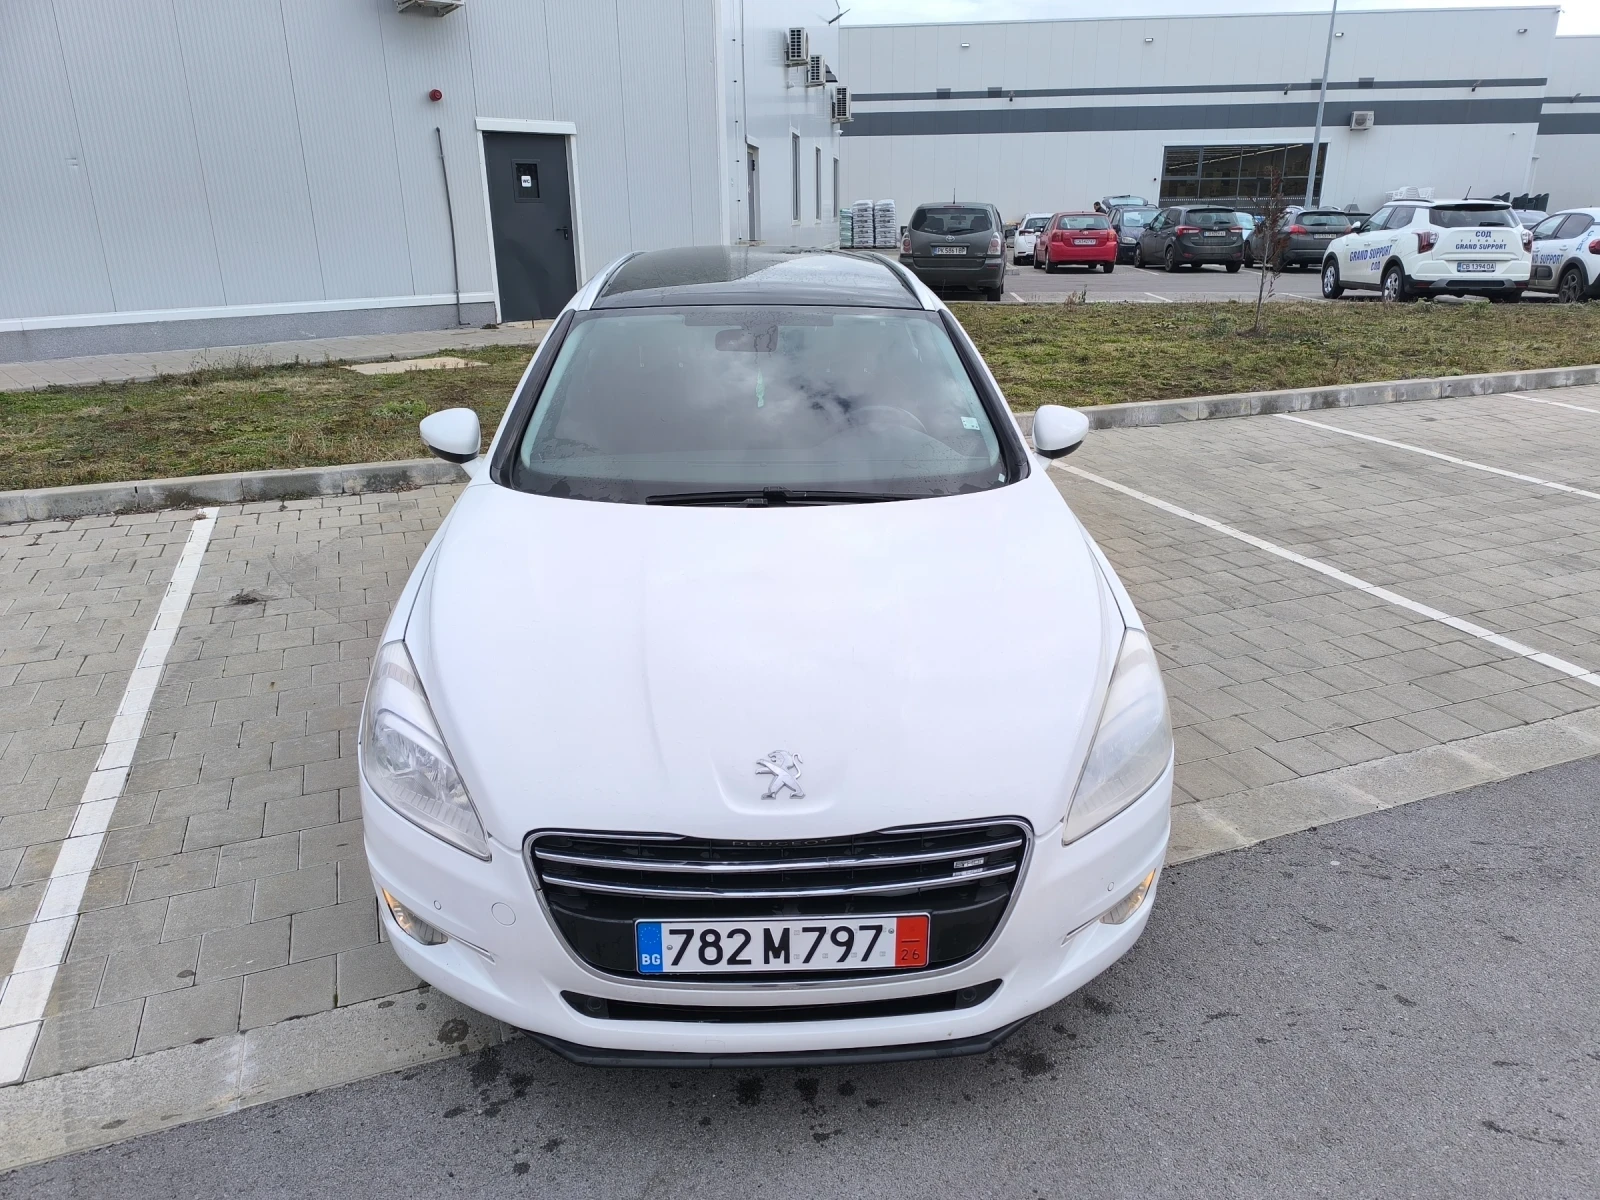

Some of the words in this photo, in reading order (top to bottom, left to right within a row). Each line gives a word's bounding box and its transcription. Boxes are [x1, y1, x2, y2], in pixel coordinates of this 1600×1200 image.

[1475, 230, 1492, 238] СОД
[1349, 249, 1369, 262] GRAND
[1369, 244, 1393, 260] SUPPORT
[1539, 254, 1564, 265] SUPPORT
[732, 838, 832, 847] PEUGEOT
[668, 927, 752, 966] 782
[763, 927, 791, 965] M
[801, 924, 884, 964] 797
[641, 953, 661, 966] BG
[901, 948, 921, 961] 26
